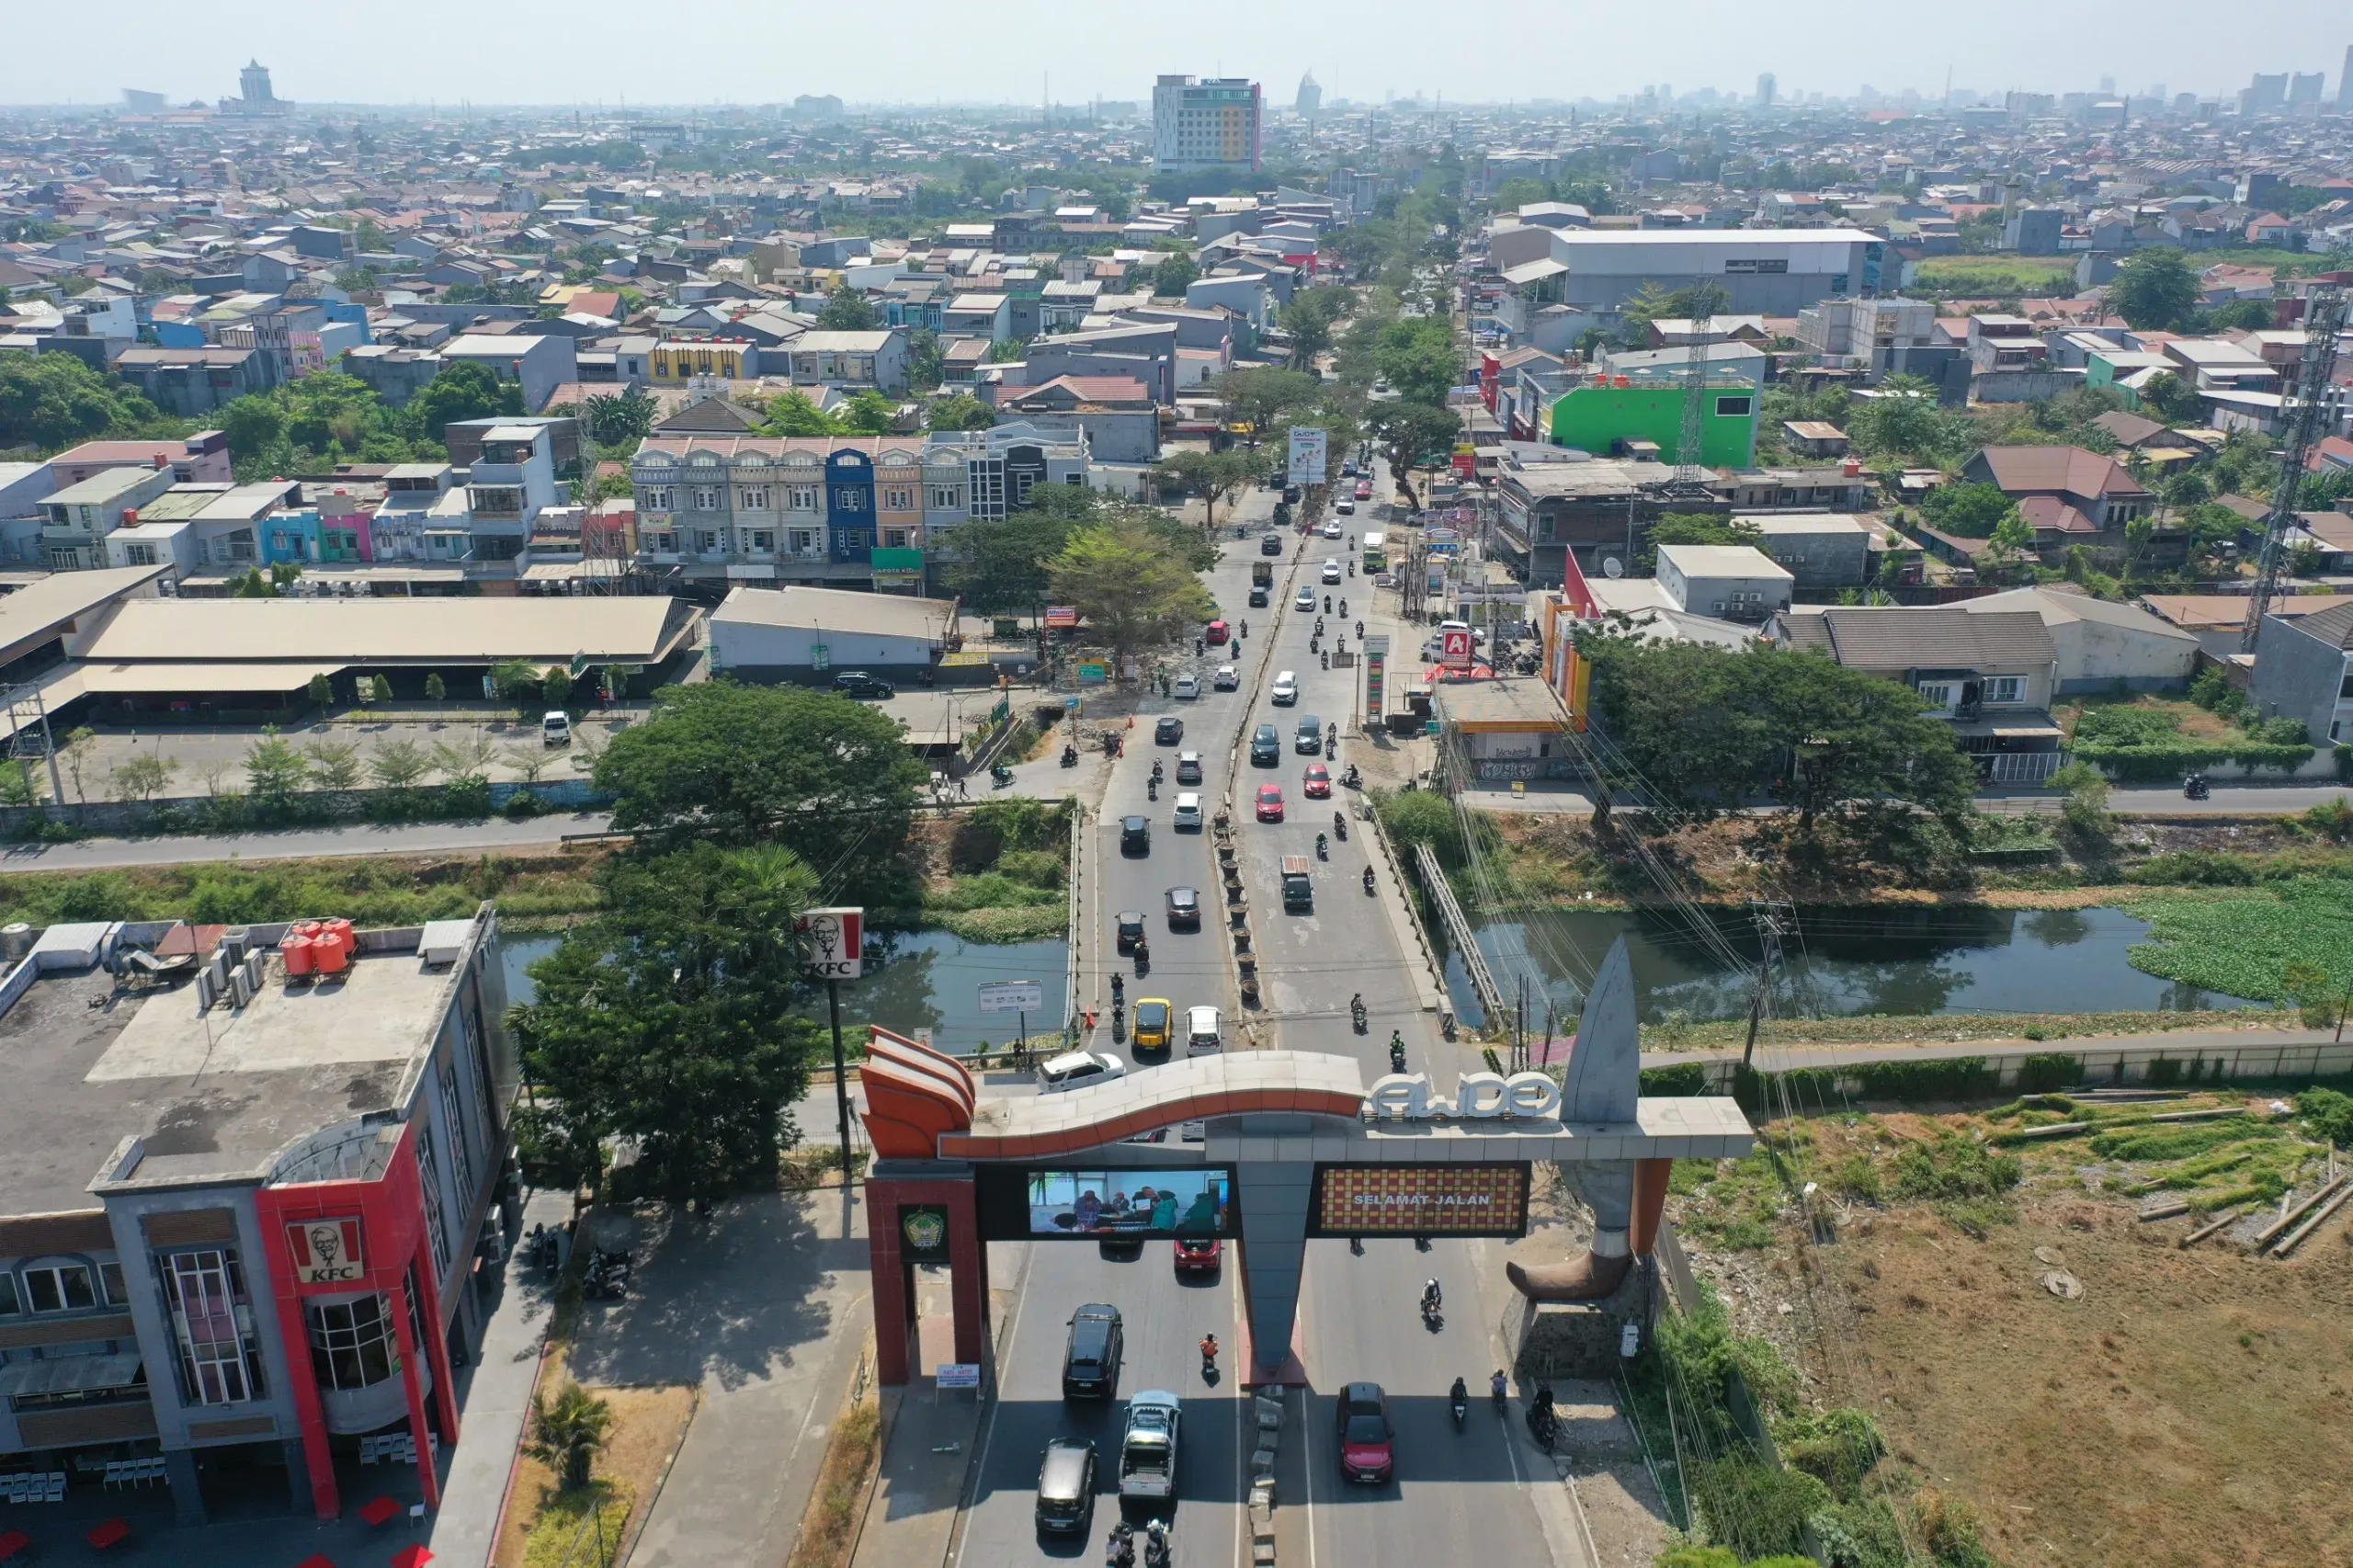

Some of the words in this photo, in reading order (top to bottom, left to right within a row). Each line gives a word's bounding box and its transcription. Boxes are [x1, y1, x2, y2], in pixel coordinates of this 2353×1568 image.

[810, 961, 851, 975] KFC
[1354, 1195, 1429, 1205] SELAMAT
[1435, 1195, 1490, 1205] JALAN
[311, 1267, 354, 1282] KFC
